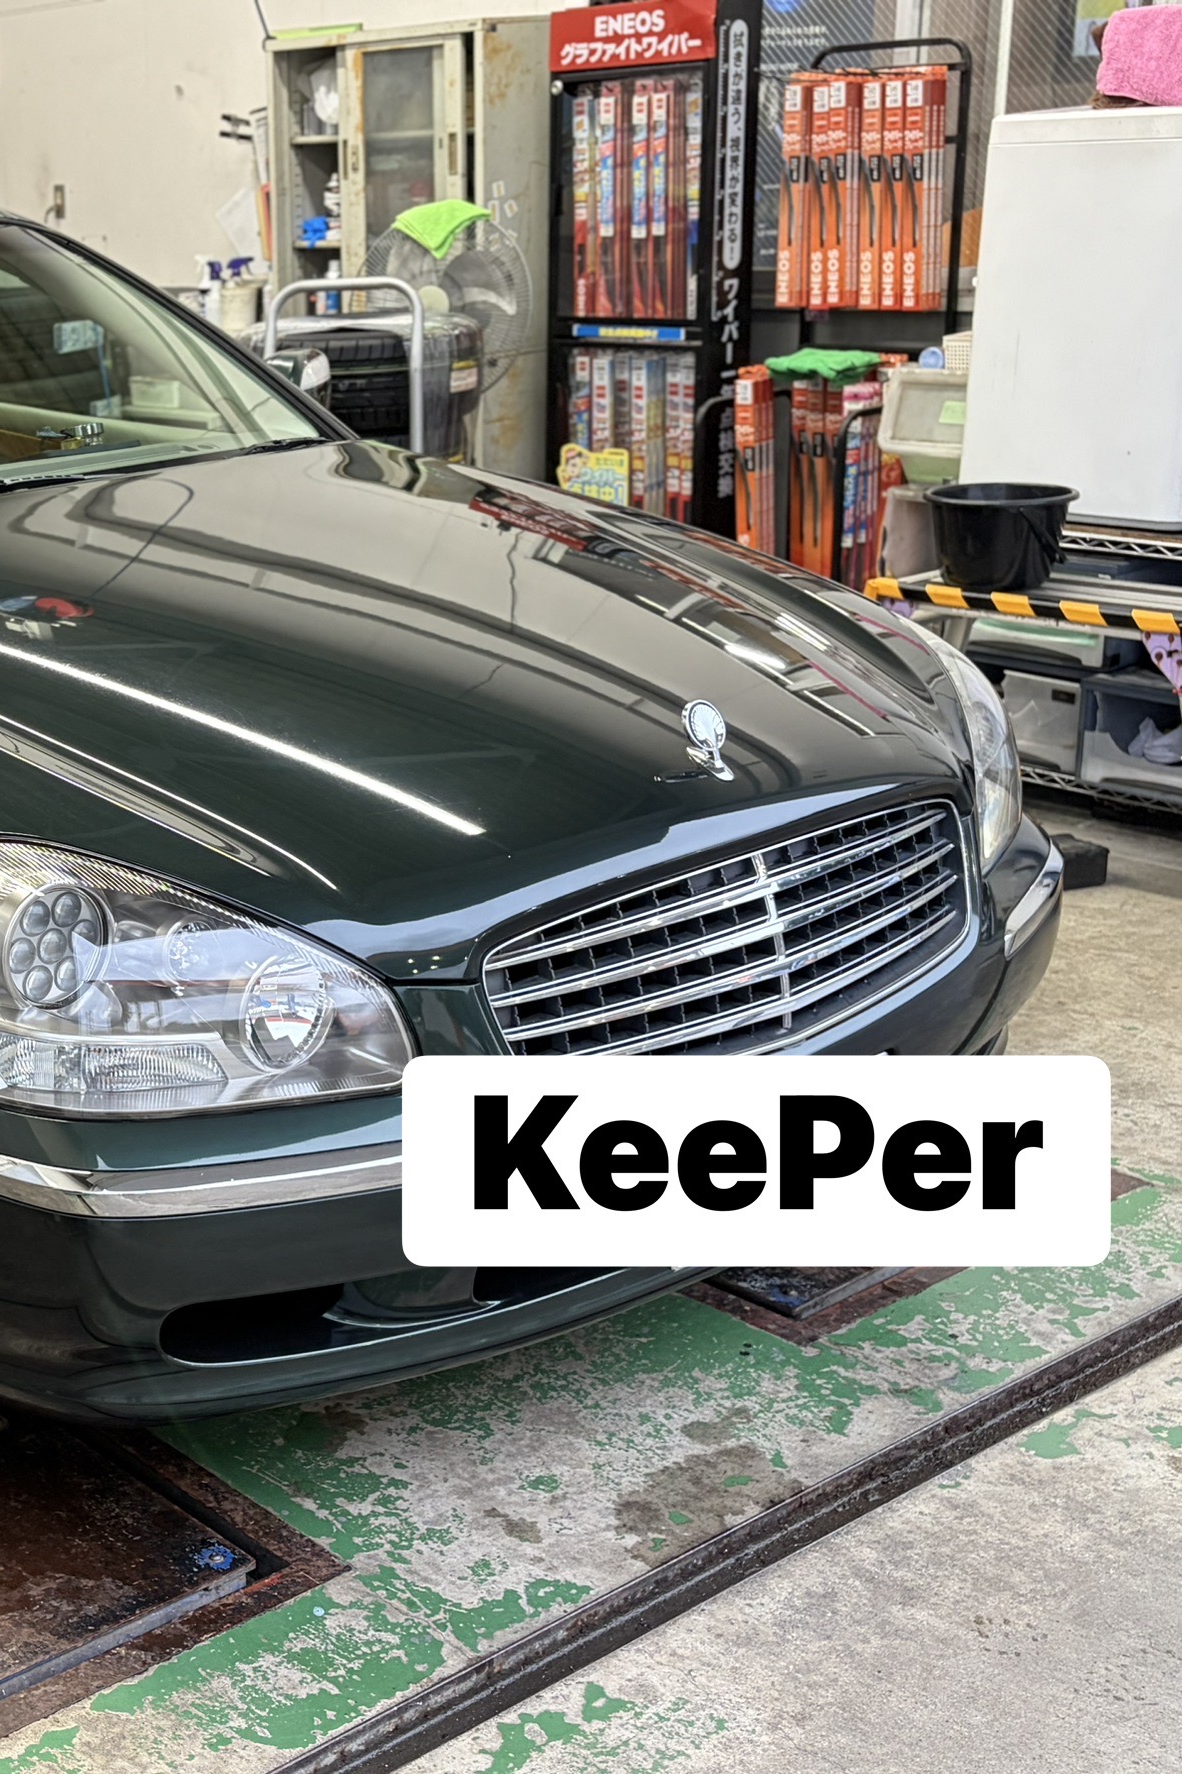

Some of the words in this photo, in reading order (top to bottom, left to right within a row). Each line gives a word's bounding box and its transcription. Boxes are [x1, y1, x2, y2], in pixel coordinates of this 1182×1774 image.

[560, 31, 702, 66] グラファイトワイパー
[594, 9, 665, 38] ENEOS
[778, 250, 791, 303] ENEOS
[810, 251, 823, 305] ENEOS
[826, 249, 839, 303] ENEOS
[859, 251, 872, 305] ENEOS
[882, 251, 895, 305] ENEOS
[903, 251, 916, 307] ENEOS
